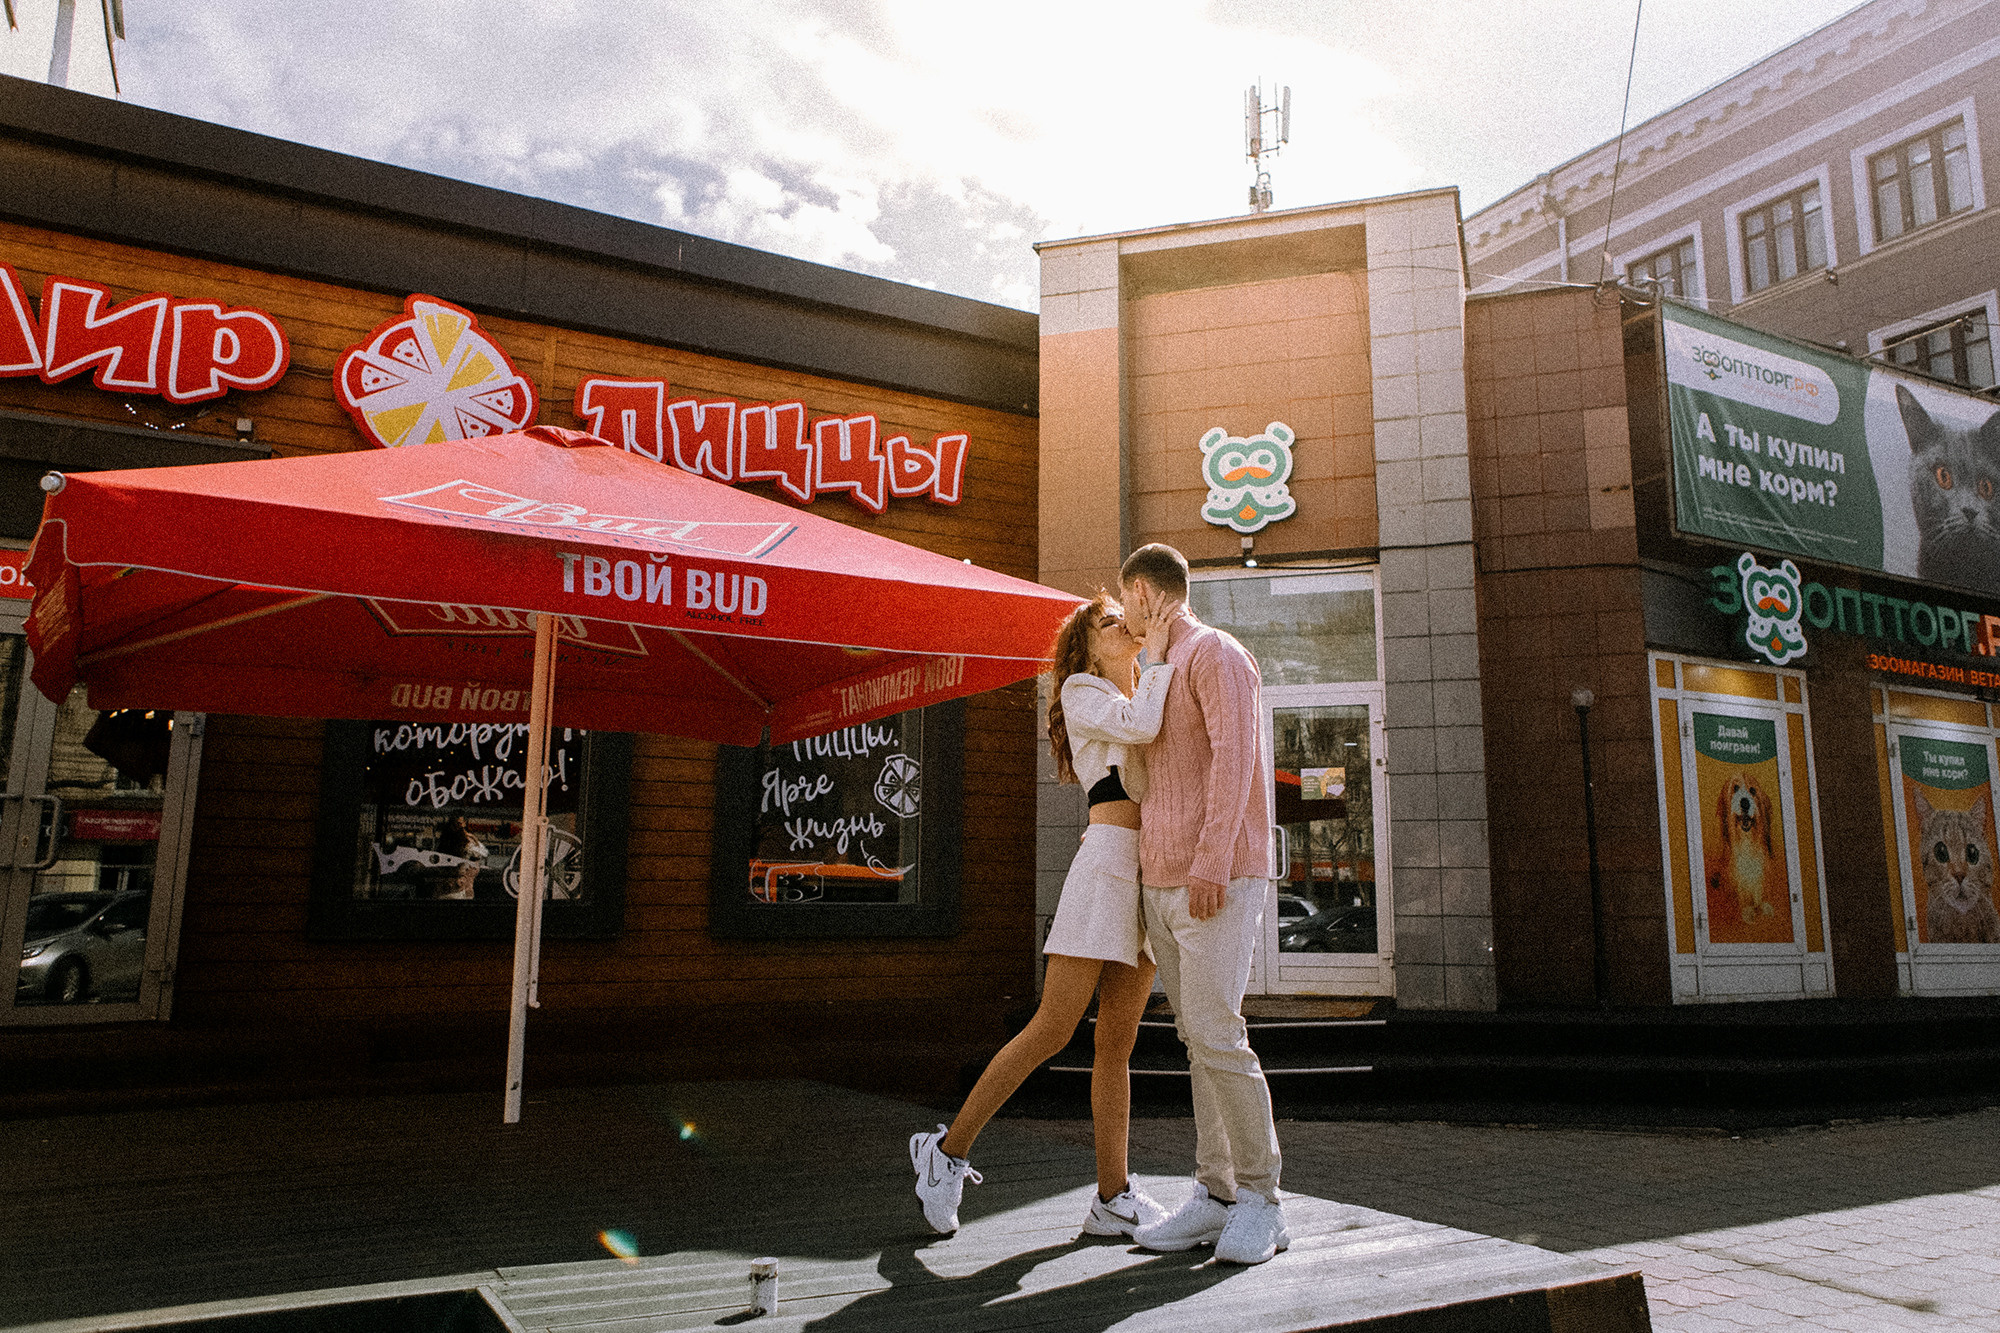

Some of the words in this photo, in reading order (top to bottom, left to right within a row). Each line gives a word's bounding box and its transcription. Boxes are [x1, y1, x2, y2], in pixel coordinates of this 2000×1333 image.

[1696, 411, 1716, 443] А
[1724, 420, 1760, 453] ты
[1767, 434, 1845, 475] купил
[1698, 453, 1751, 487] мне
[1759, 467, 1838, 507] корм?
[458, 487, 703, 541] Bud
[555, 552, 672, 606] ТВОЙ
[685, 568, 768, 617] BUD
[685, 610, 735, 624] ALCOHOL
[738, 616, 766, 627] FREE
[1867, 653, 1965, 683] ЗООМАГАЗИН
[373, 722, 531, 761] котору
[1709, 740, 1761, 754] поиграем!
[1717, 724, 1749, 739] Давай
[760, 767, 834, 817] Ярче
